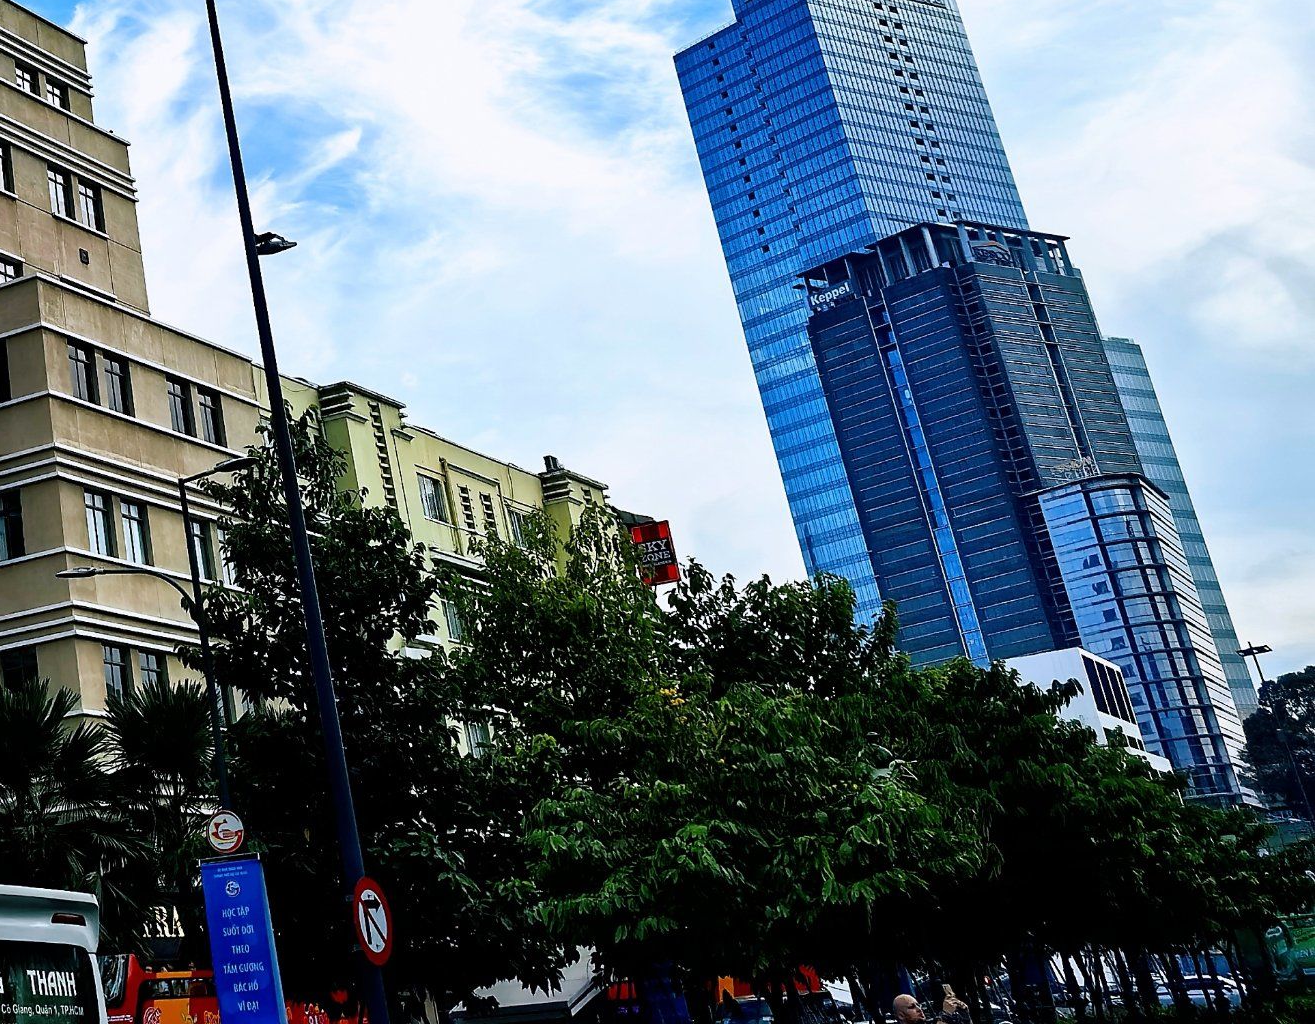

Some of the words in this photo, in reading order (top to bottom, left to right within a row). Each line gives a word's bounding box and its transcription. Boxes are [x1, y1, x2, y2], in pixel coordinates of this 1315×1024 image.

[810, 282, 850, 306] Keppel
[231, 944, 250, 954] THEO
[26, 970, 77, 996] THANH
